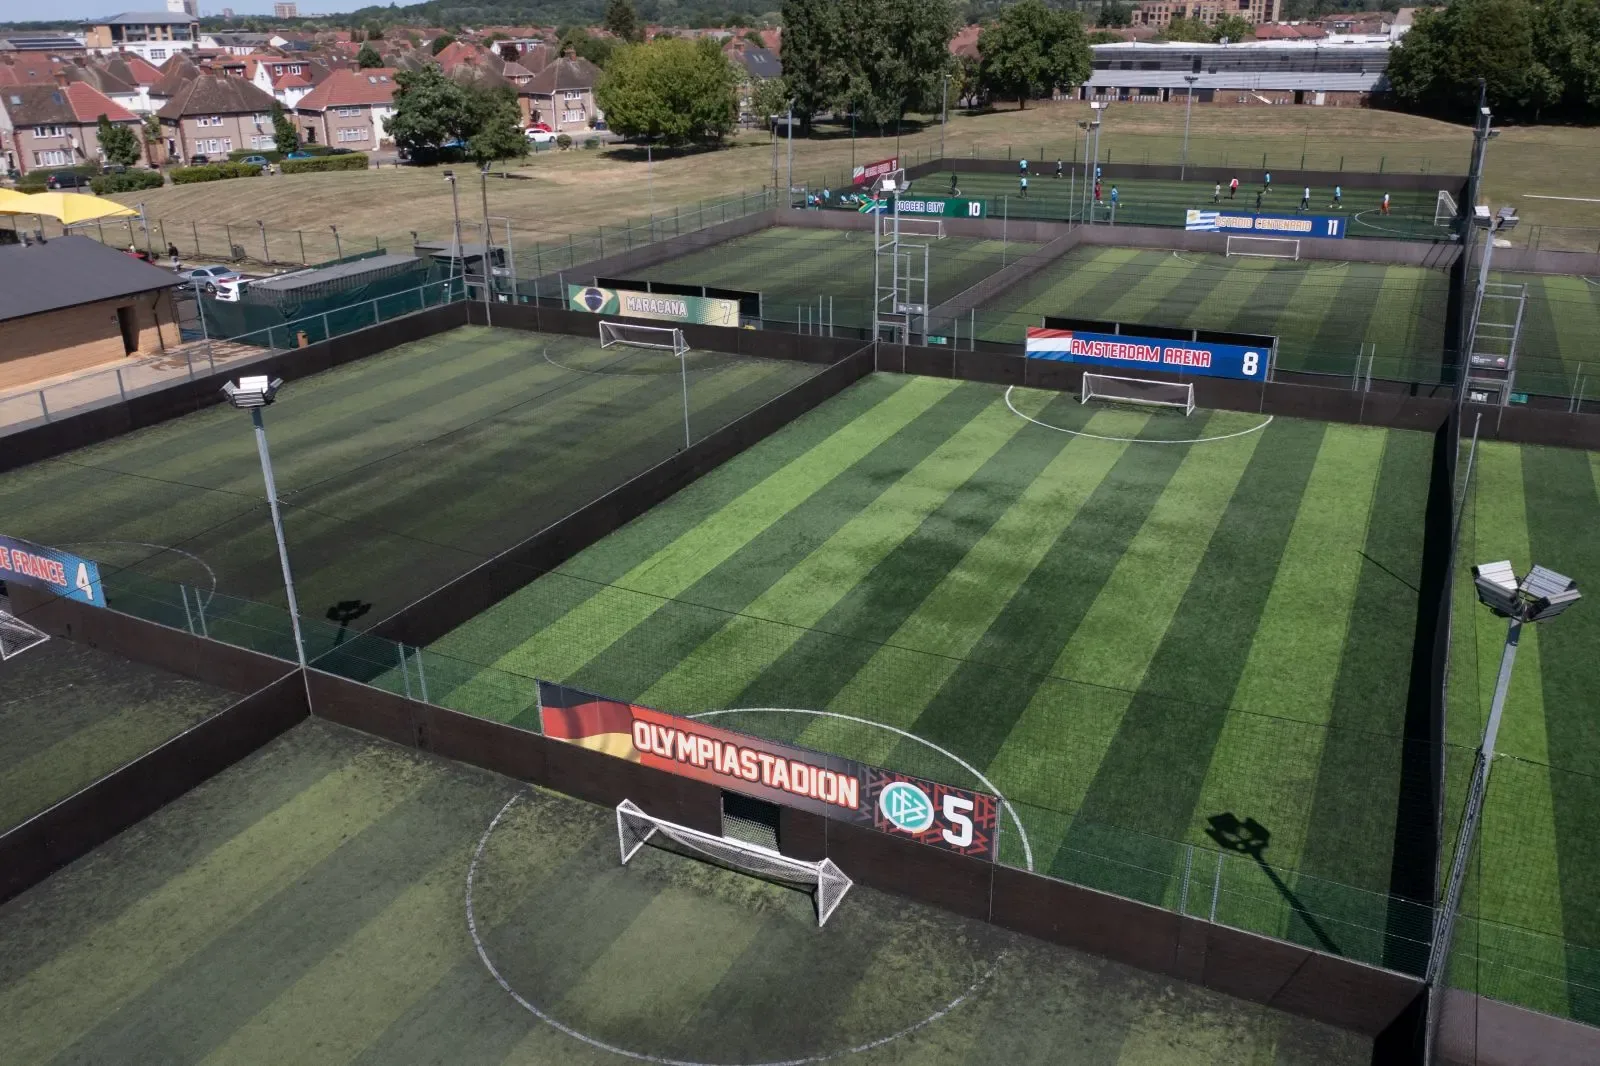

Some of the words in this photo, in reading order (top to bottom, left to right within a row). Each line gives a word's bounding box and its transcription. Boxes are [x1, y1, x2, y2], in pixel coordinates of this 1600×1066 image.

[926, 202, 945, 213] CITY
[968, 201, 981, 217] 10
[1327, 219, 1339, 236] 11
[626, 296, 688, 318] MARACANA
[720, 302, 732, 325] 7
[1071, 339, 1161, 363] AMSTERDAM
[1163, 348, 1212, 368] ARENA
[1242, 352, 1260, 376] 8
[11, 549, 67, 587] FRANCE
[76, 562, 94, 601] 4
[632, 719, 860, 810] OLYMPIASTADION
[942, 794, 974, 847] 5
